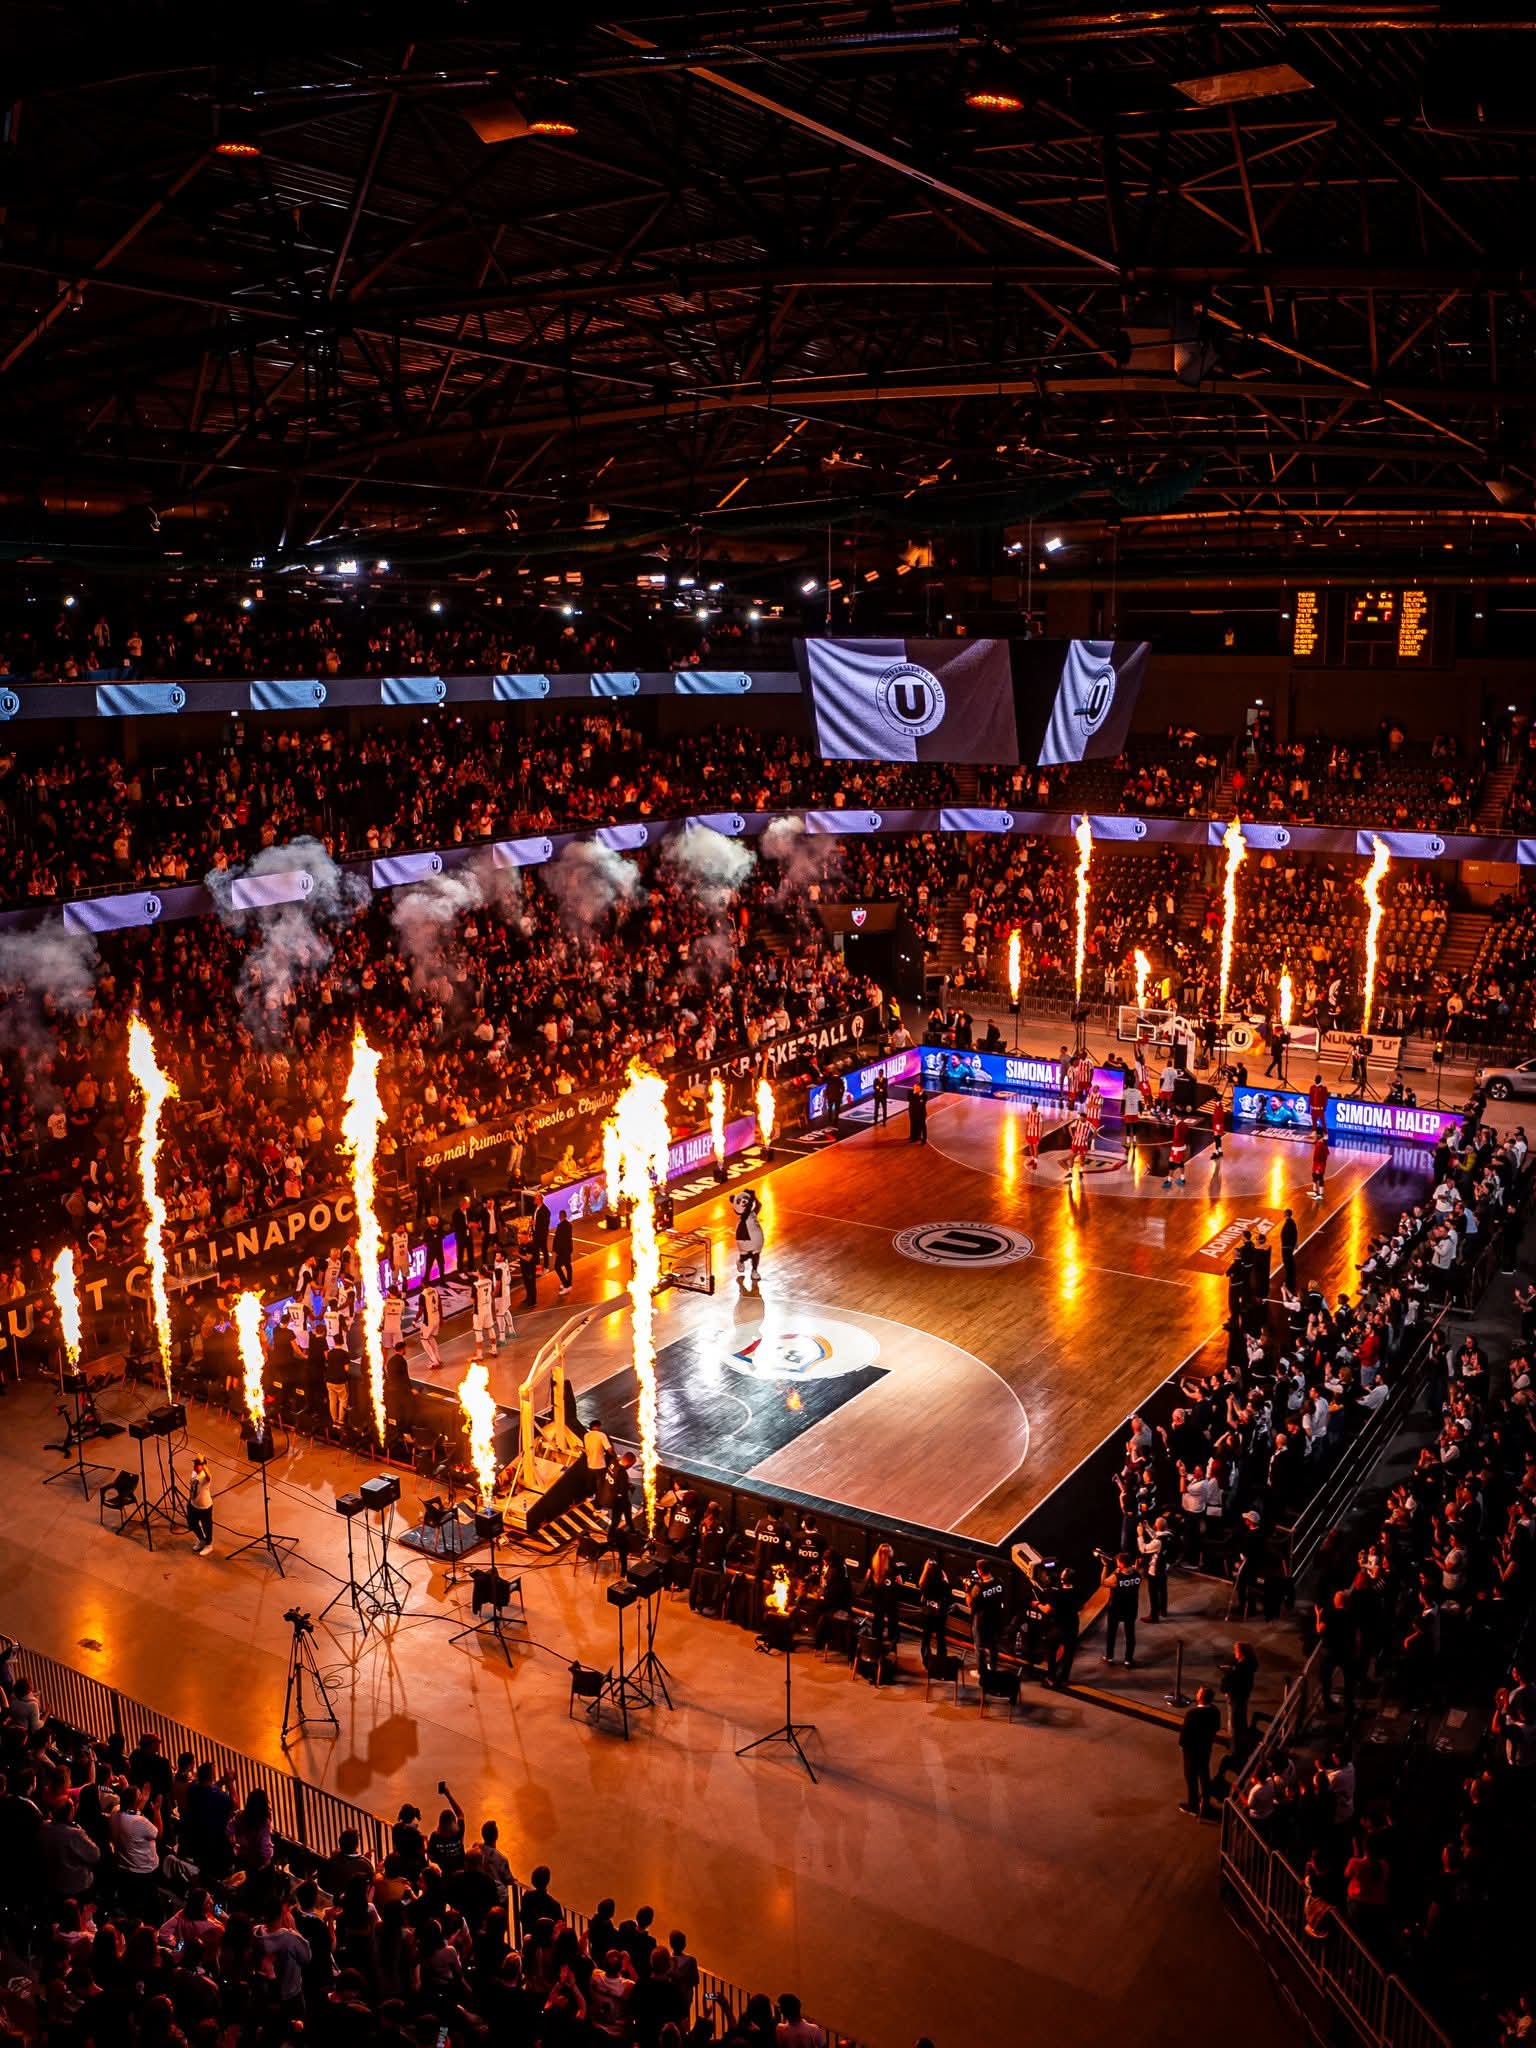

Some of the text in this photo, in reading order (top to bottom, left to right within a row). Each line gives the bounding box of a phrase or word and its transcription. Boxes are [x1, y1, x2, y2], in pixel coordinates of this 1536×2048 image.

[881, 664, 934, 685] UNIVERSITATEA
[933, 683, 944, 703] CLUJ
[893, 684, 926, 719] U
[1088, 684, 1109, 720] U
[1234, 1032, 1246, 1045] U
[1005, 1060, 1053, 1084] SIMONA
[1335, 1103, 1441, 1134] SIMONA HALEP
[444, 1141, 466, 1161] mai
[566, 1107, 575, 1119] a
[926, 1231, 1002, 1256] U
[1199, 1217, 1261, 1258] ADMIRAL
[674, 1514, 691, 1525] OTO
[758, 1533, 780, 1544] FOTO
[982, 1585, 1003, 1598] FOTO
[1119, 1577, 1141, 1588] FOTO
